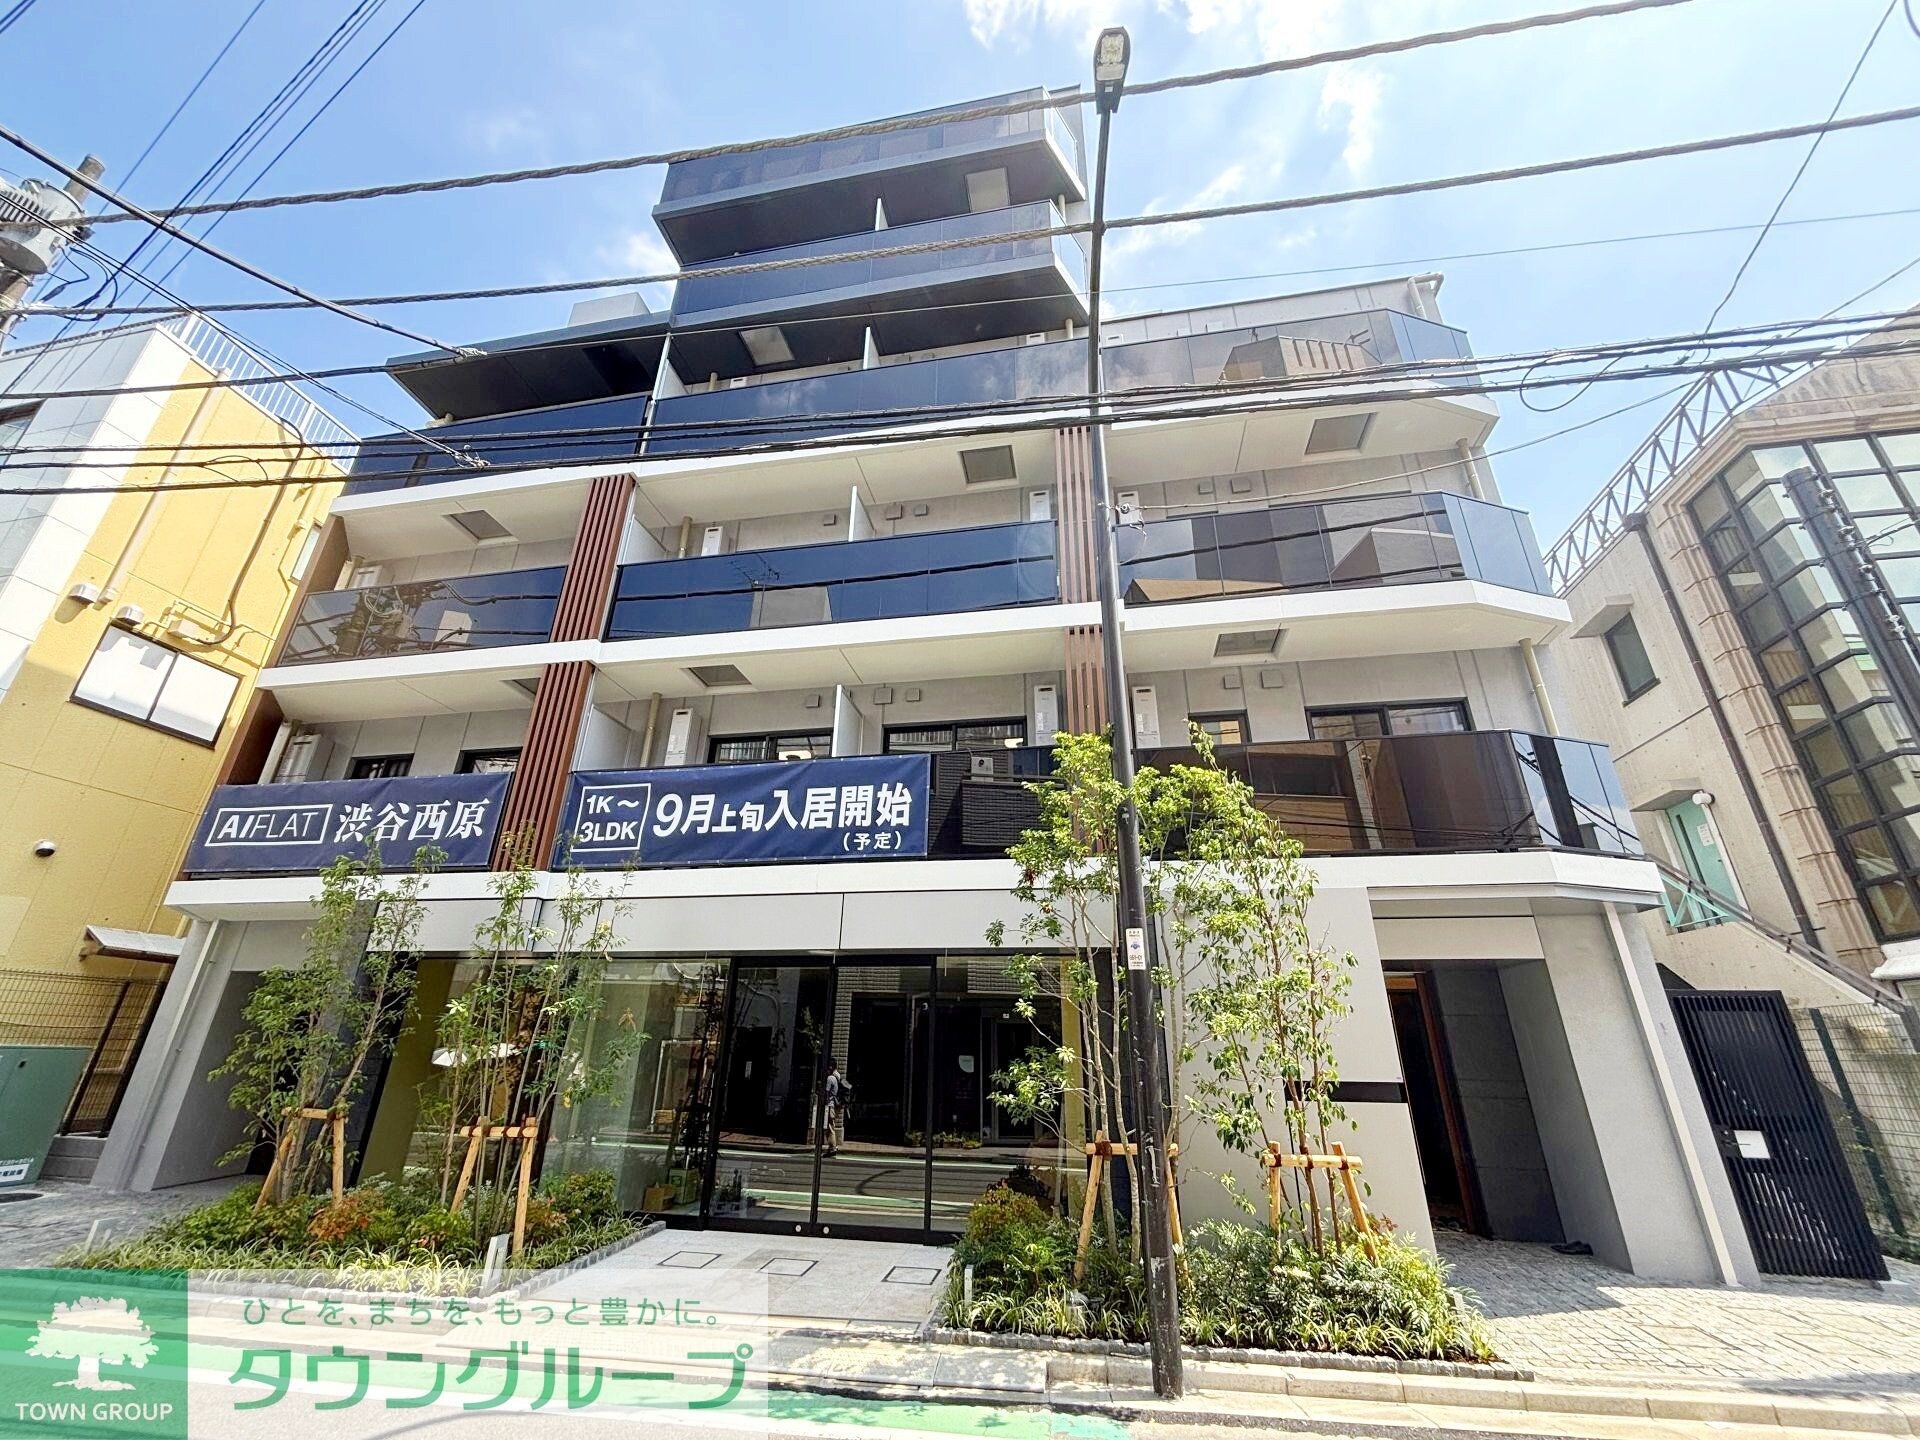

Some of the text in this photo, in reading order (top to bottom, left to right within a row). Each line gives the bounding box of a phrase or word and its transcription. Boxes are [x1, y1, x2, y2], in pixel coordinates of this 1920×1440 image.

[217, 798, 490, 843] AIFLAT 渋谷西原
[652, 782, 912, 837] 9月上旬入居開始
[579, 821, 639, 843] 3LDK
[842, 831, 903, 852] (予定)
